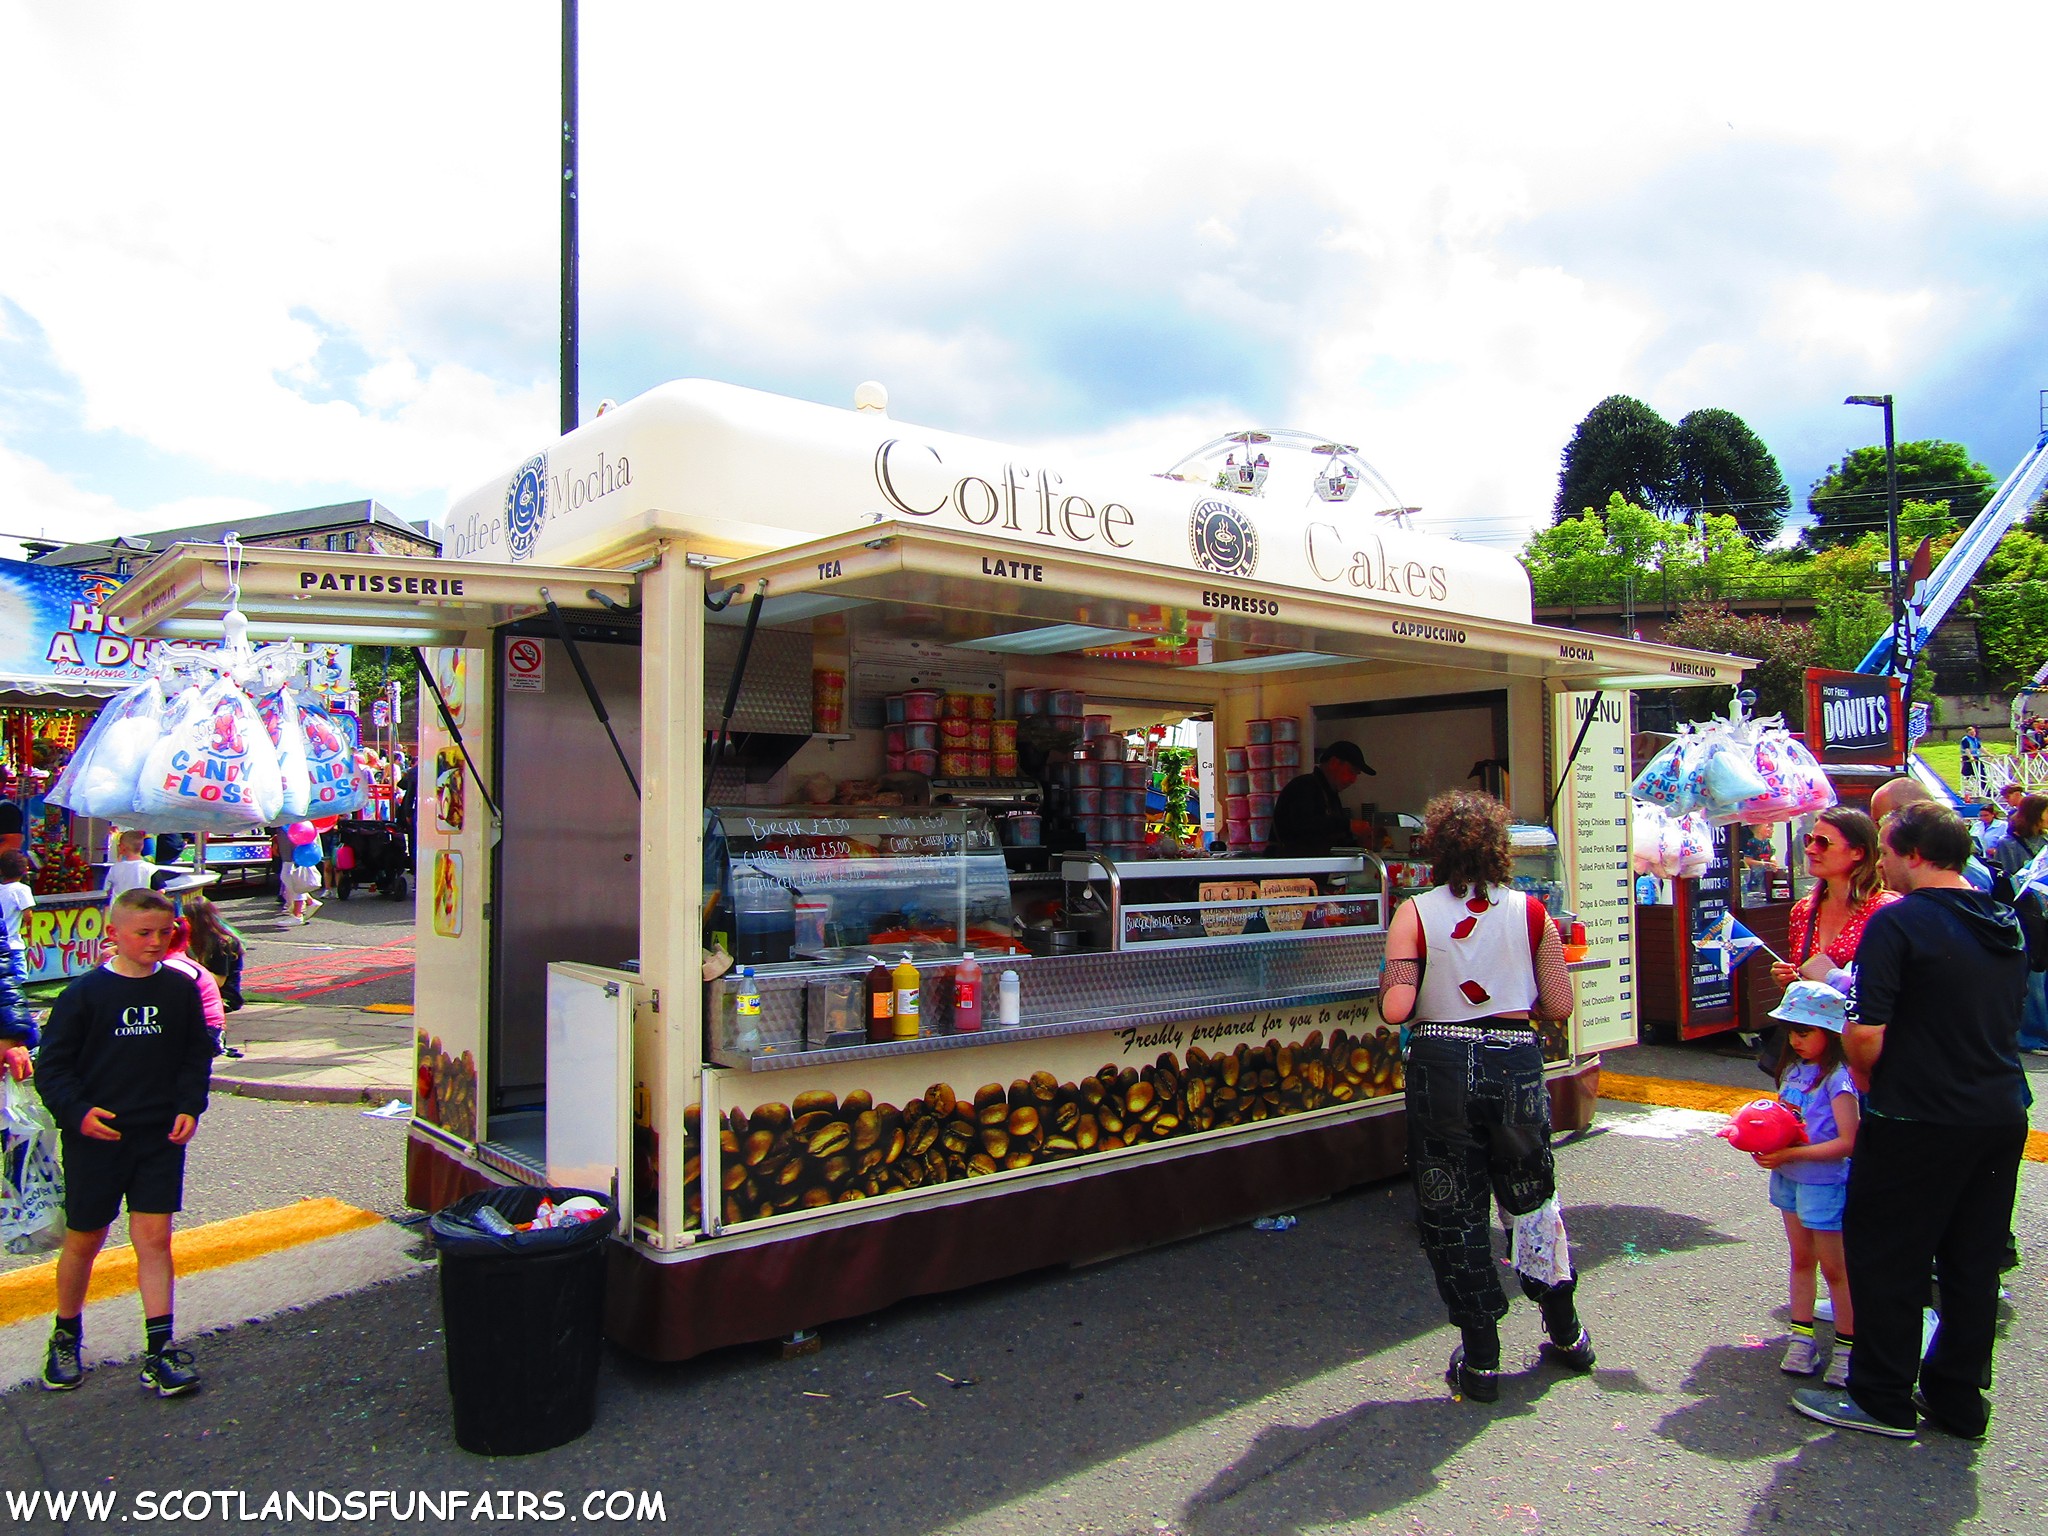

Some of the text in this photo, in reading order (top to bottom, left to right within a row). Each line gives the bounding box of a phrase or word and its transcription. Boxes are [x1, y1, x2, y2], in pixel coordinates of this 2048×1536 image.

[551, 452, 633, 521] Mocha
[874, 439, 1135, 548] Coffee
[1197, 502, 1251, 534] SPECIALITY
[818, 560, 842, 581] TEA
[982, 557, 1043, 583] LATTE
[1304, 521, 1448, 602] Cakes
[300, 572, 464, 596] PATISSERIE
[1202, 591, 1280, 617] ESPRESSO
[1392, 620, 1467, 644] CAPPUCCINO
[47, 632, 83, 664] A
[1559, 645, 1594, 662] MOCHA
[54, 660, 139, 679] Everyone's
[1670, 661, 1716, 678] AMERICANO
[1575, 697, 1622, 724] MENU
[1823, 695, 1887, 742] DONUTS
[172, 750, 254, 782] CANDY
[308, 755, 354, 784] NDY
[1577, 763, 1593, 772] Cheese
[1577, 773, 1592, 781] Burger
[163, 772, 253, 805] FLOSS
[1577, 791, 1596, 799] Chicken
[1577, 801, 1593, 810] Burger
[747, 817, 809, 841] BURGER
[1577, 818, 1590, 827] Spicy
[1591, 818, 1610, 826] Chicken
[1578, 828, 1594, 837] Burger
[890, 837, 914, 852] CHIPS
[1579, 845, 1593, 853] Pulled
[1594, 845, 1605, 853] Pork
[1606, 844, 1615, 852] Roll
[744, 850, 779, 869] CHEESE
[785, 845, 820, 862] BURGER
[1579, 863, 1593, 871] Pulled
[1594, 863, 1605, 871] Pork
[1606, 862, 1615, 870] Roll
[747, 875, 797, 894] CHICKEN
[1579, 882, 1593, 890] Chips
[1700, 877, 1721, 890] DONUTS
[1580, 901, 1594, 909] Chips
[1599, 899, 1617, 908] Cheese
[1599, 919, 1612, 928] Curry
[1600, 936, 1614, 945] Gravy
[1582, 981, 1597, 989] Coffee
[1582, 999, 1590, 1007] Hot
[1592, 995, 1615, 1007] Chocolate
[122, 1006, 159, 1026] C.P.
[1190, 1015, 1257, 1046] prepared
[1262, 1013, 1283, 1038] for
[1290, 1010, 1313, 1032] you
[1318, 1005, 1331, 1023] to
[1583, 1016, 1610, 1028] Cold Drinks
[115, 1025, 163, 1037] COMPANY
